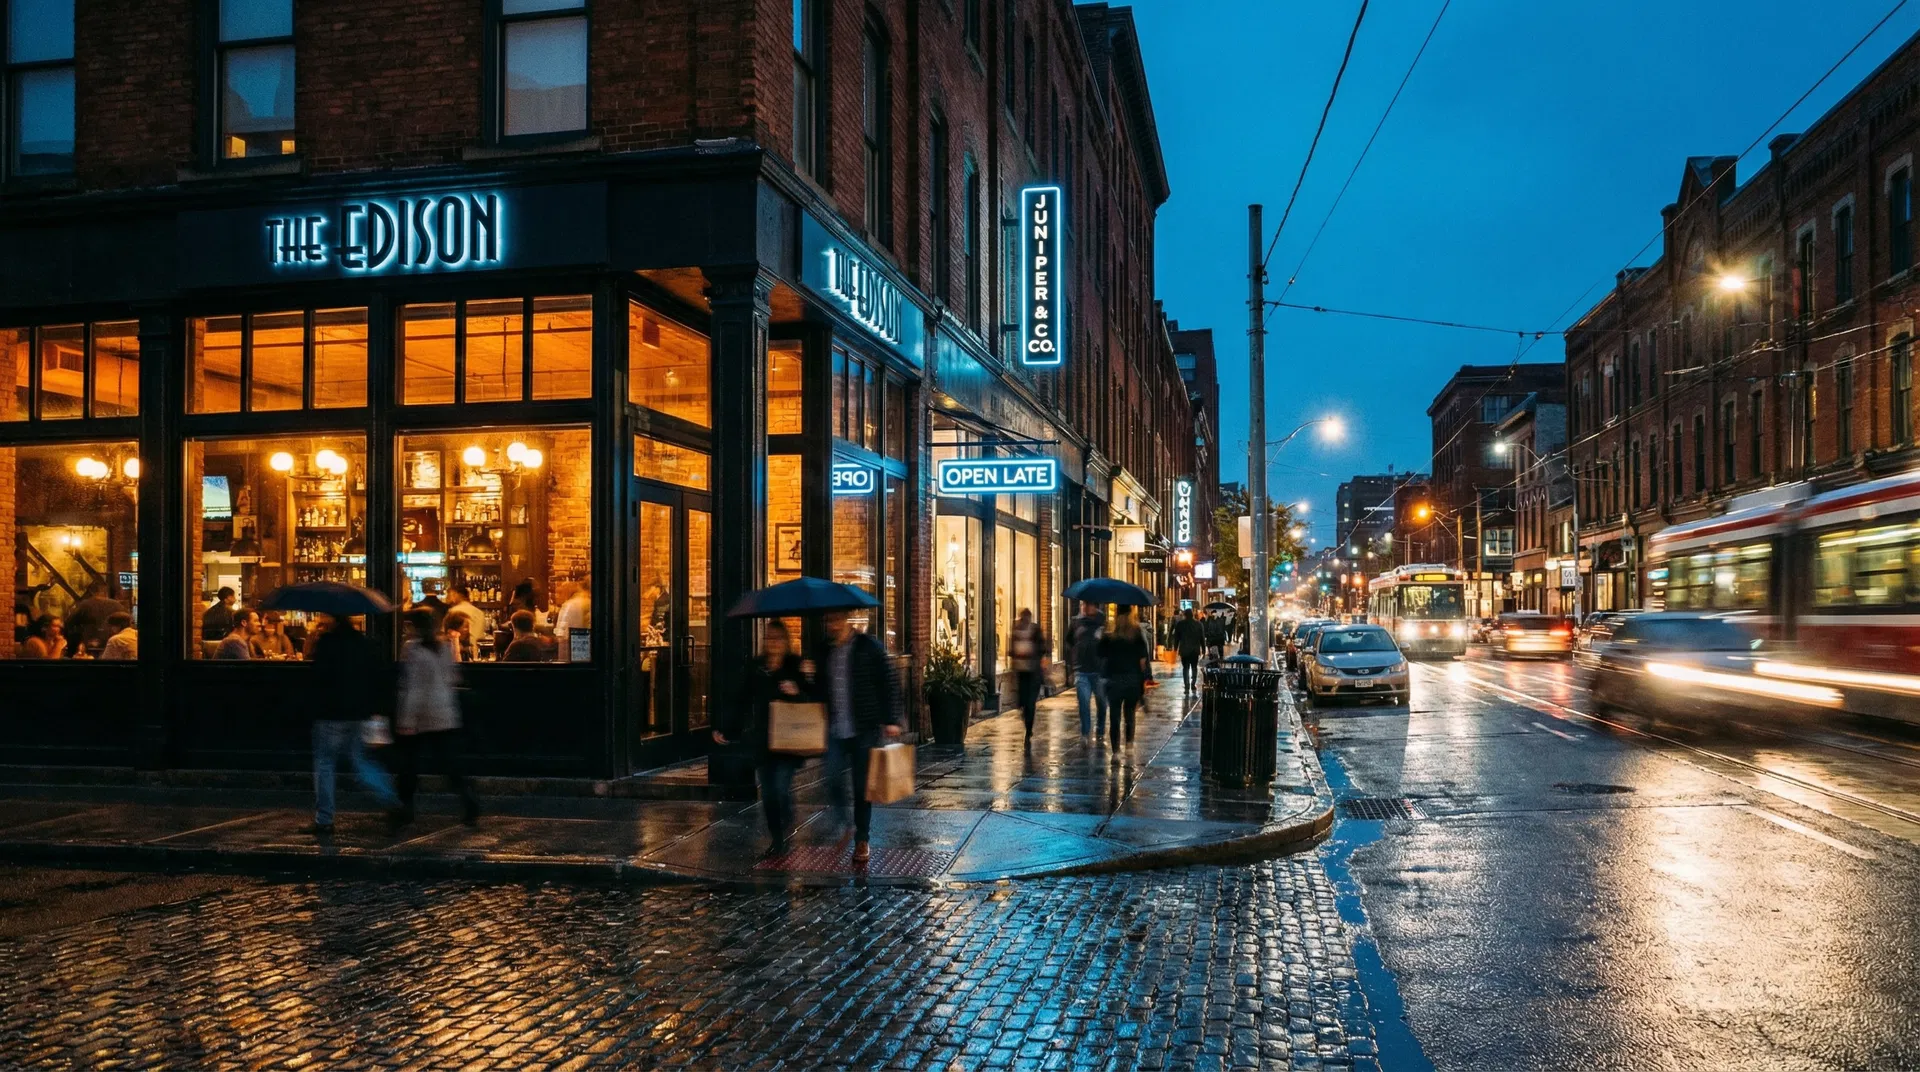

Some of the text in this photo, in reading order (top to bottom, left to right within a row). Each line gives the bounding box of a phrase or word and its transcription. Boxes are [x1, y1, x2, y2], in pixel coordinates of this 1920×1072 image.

[265, 194, 498, 269] THE EDISON
[1034, 194, 1048, 300] JUNIPER
[1034, 305, 1048, 319] &
[945, 466, 1048, 485] OPEN LATE
